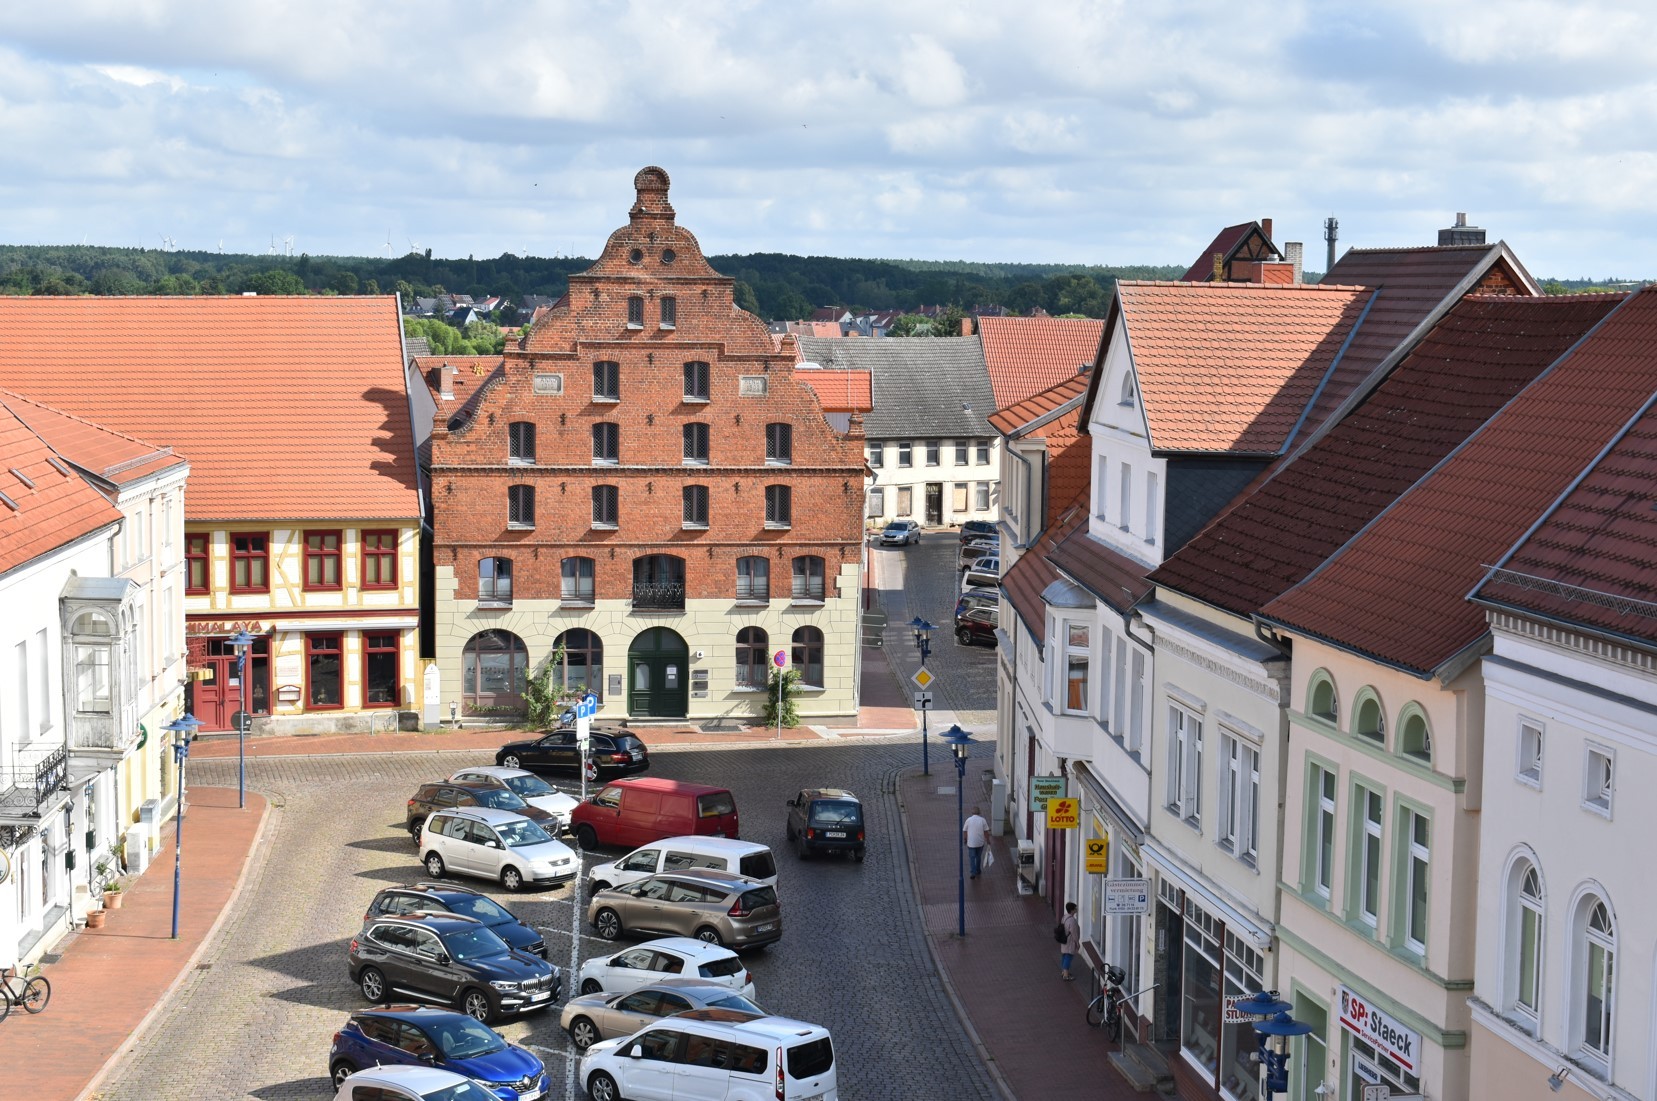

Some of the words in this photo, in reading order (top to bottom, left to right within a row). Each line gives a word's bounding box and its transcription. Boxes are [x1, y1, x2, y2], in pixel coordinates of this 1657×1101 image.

[1350, 998, 1368, 1027] SP:
[1370, 1011, 1412, 1058] Staeck
[1361, 1030, 1390, 1054] ServicePartner
